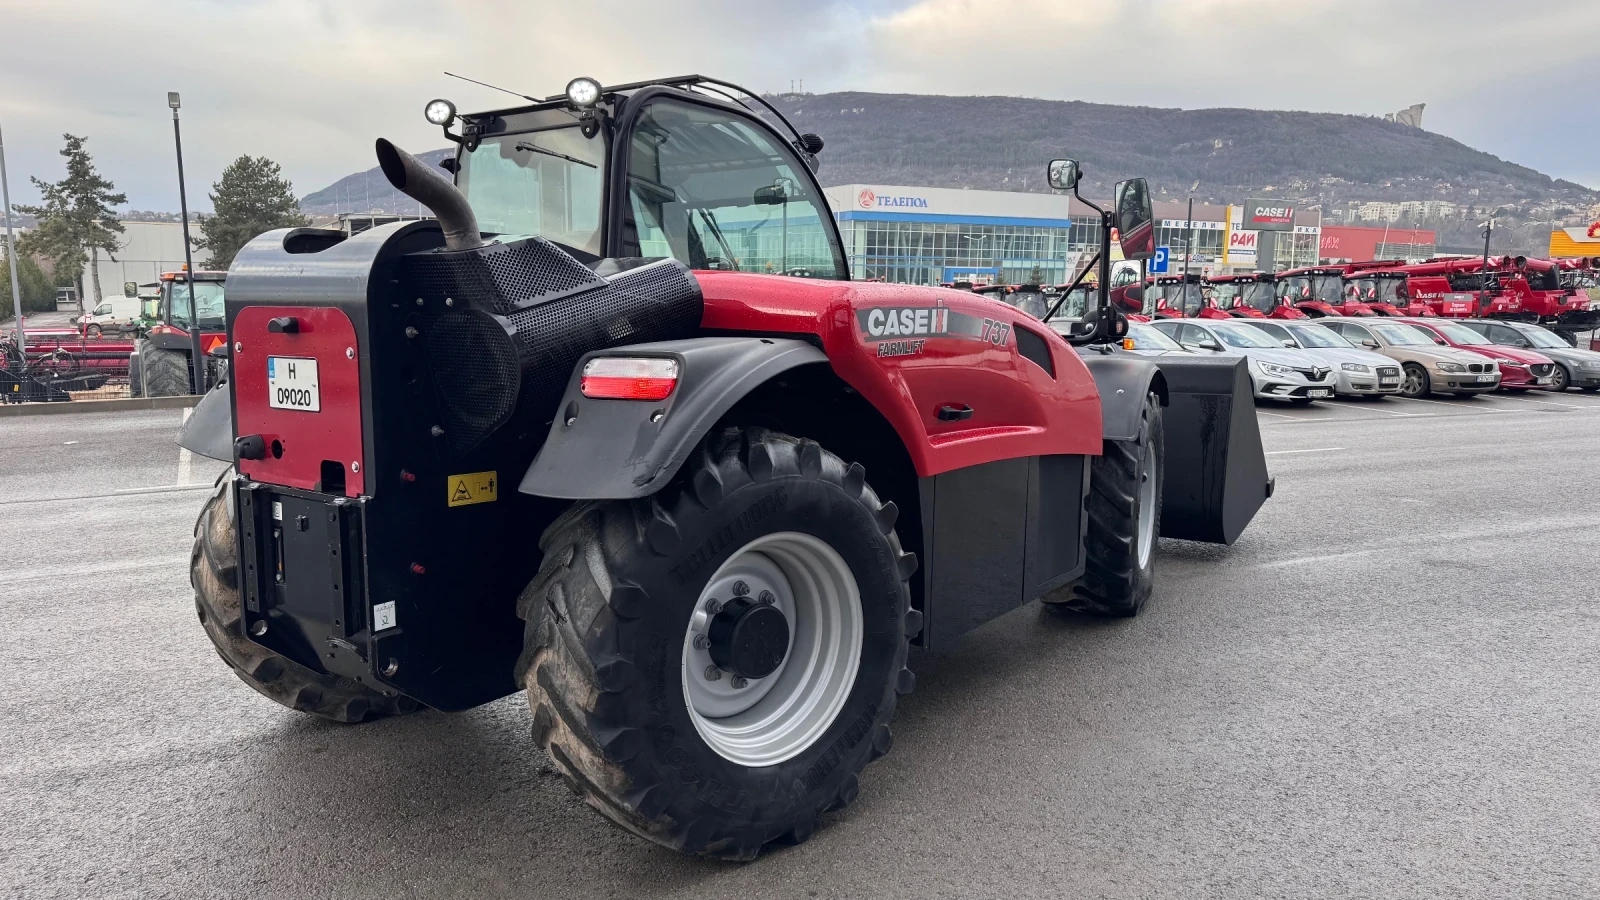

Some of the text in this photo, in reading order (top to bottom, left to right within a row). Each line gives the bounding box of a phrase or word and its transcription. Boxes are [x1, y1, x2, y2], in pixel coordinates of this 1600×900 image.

[876, 195, 928, 208] ТЕЛЕПОЛ
[1255, 206, 1285, 217] CASE
[1164, 220, 1216, 229] МЕБЕЛИ
[1153, 250, 1165, 271] P
[867, 308, 929, 337] CASE
[982, 317, 1012, 347] 737
[877, 339, 925, 358] FARMLIFT
[288, 362, 297, 379] H
[277, 387, 311, 406] 09020
